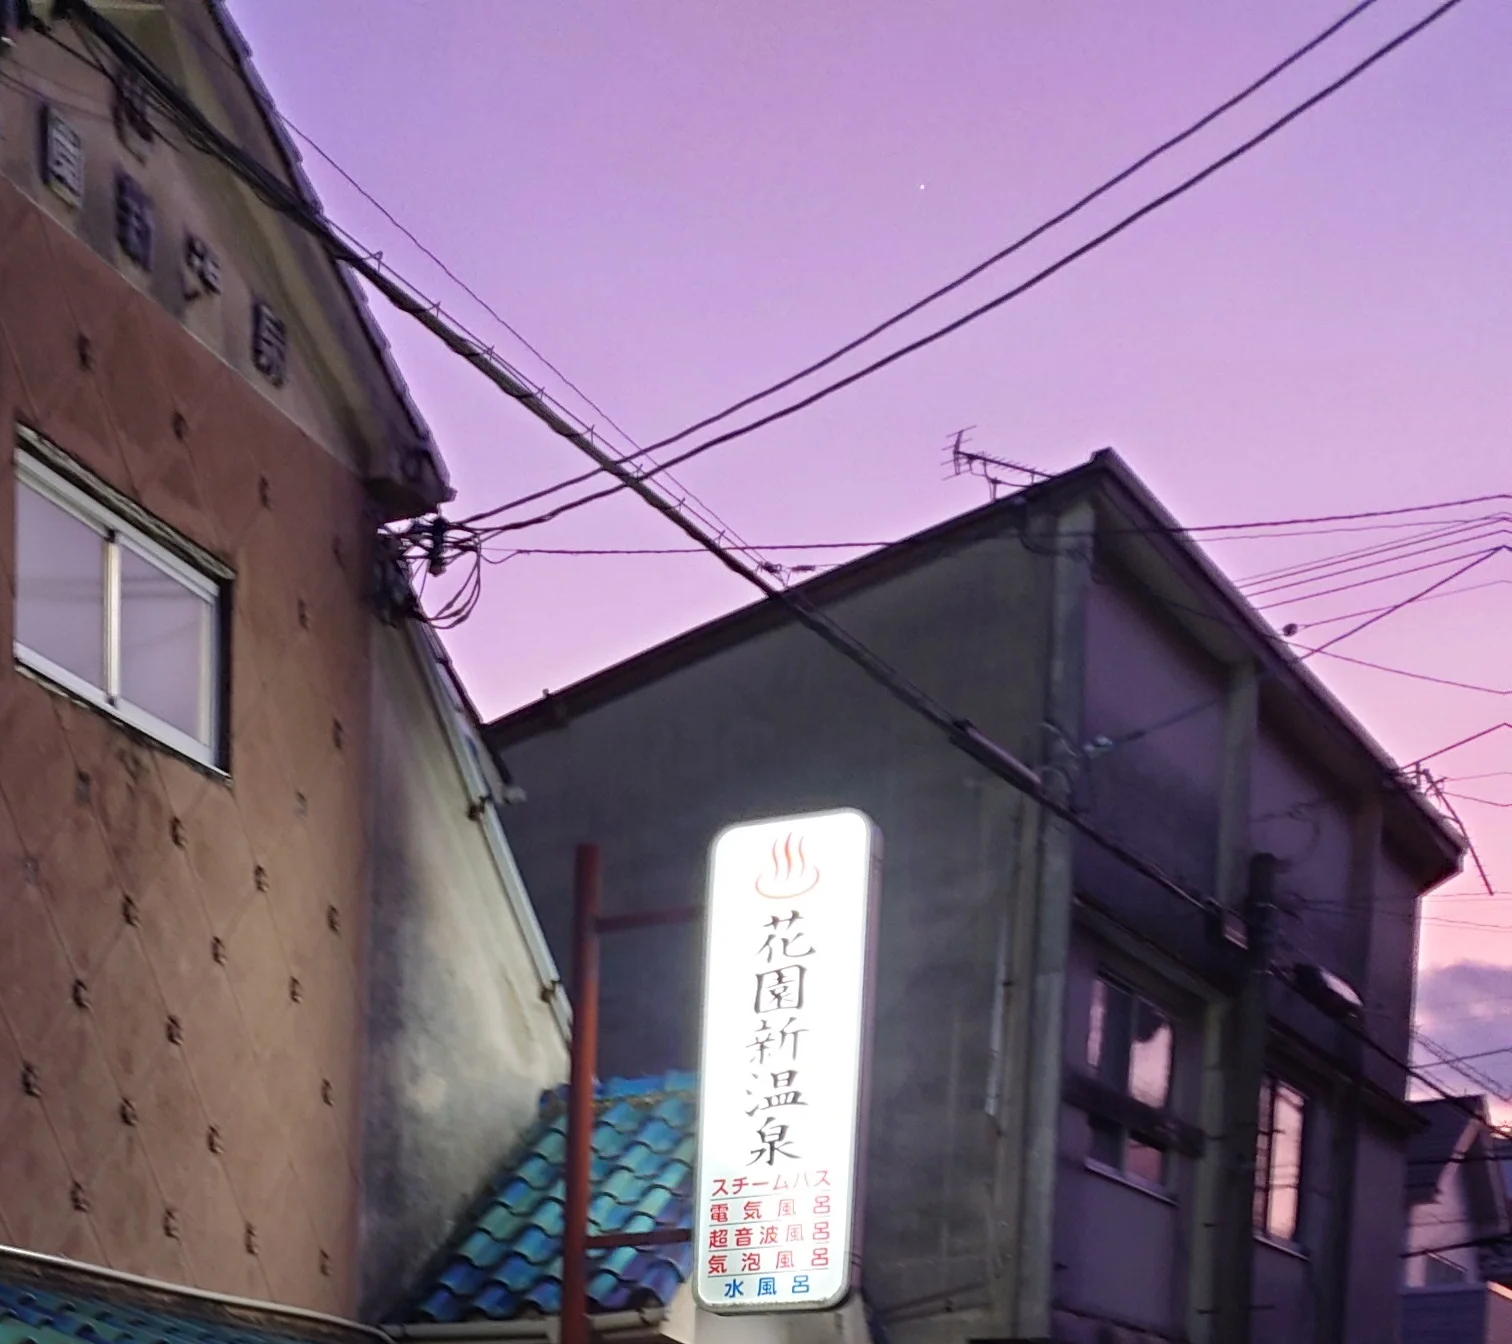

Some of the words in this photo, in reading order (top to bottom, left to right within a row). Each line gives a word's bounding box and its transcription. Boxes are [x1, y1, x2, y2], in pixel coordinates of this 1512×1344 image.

[744, 909, 817, 1168] 花園新温泉
[709, 1195, 832, 1224] 電気風呂
[708, 1221, 831, 1250] 超音波風呂
[707, 1247, 830, 1275] 気泡風呂
[723, 1274, 811, 1299] 水風呂
